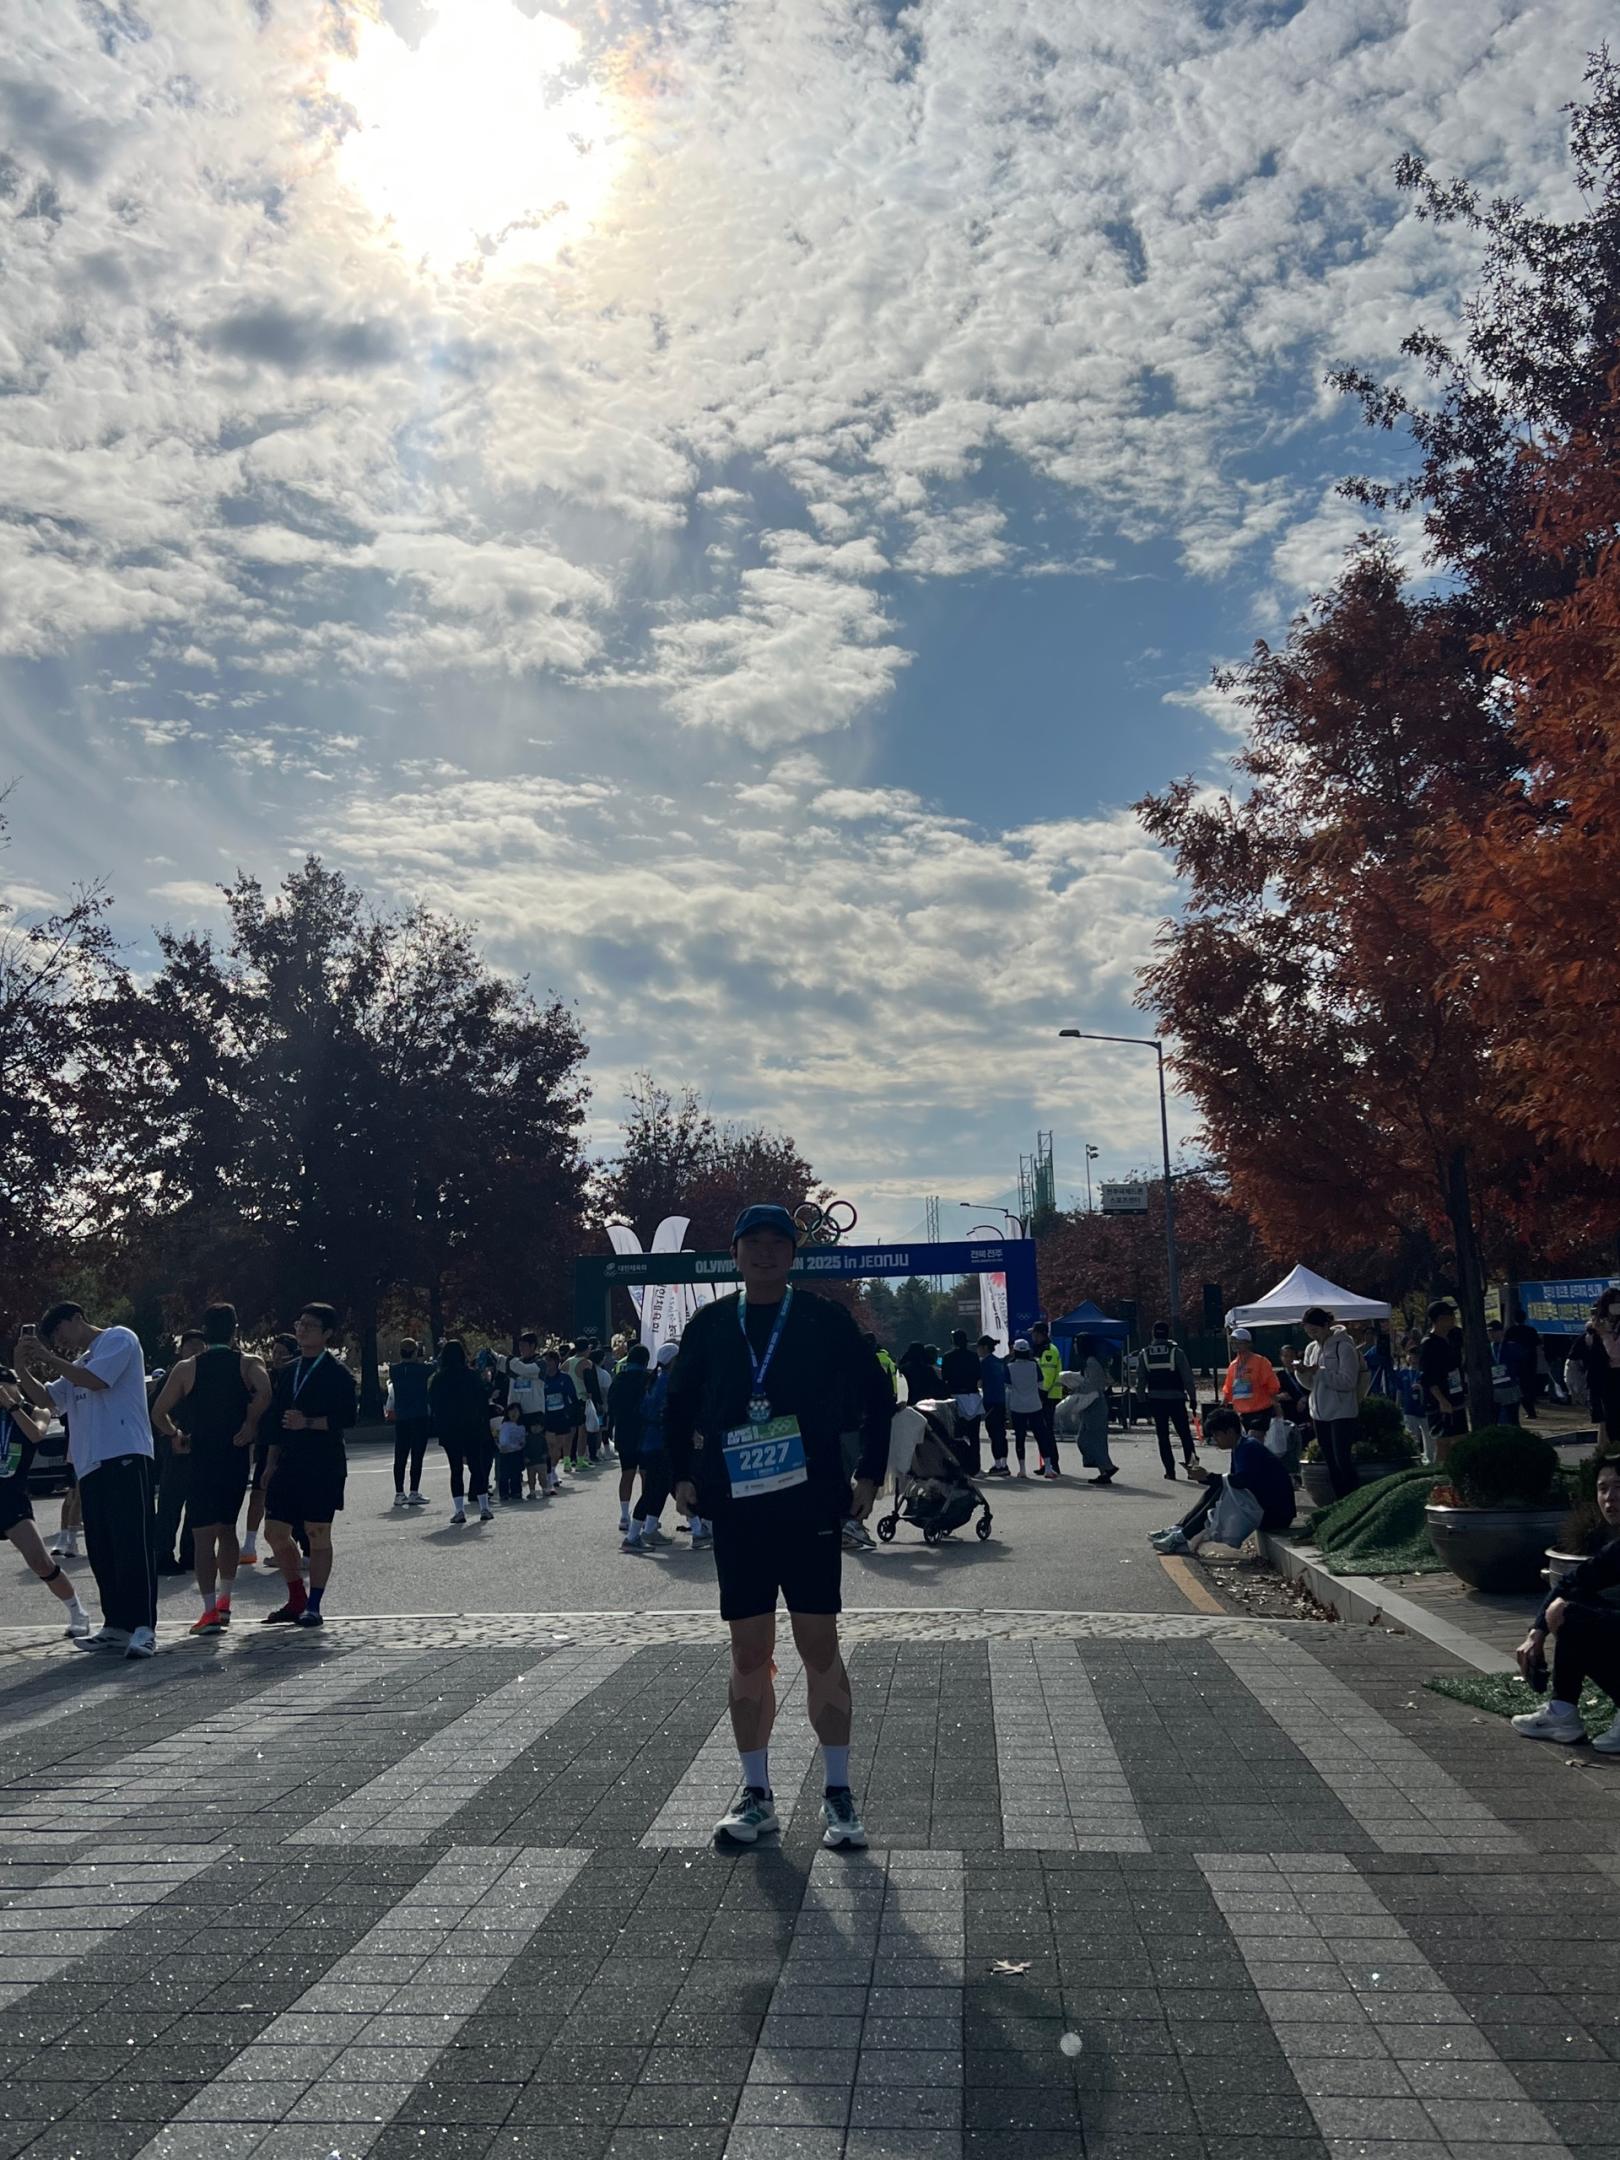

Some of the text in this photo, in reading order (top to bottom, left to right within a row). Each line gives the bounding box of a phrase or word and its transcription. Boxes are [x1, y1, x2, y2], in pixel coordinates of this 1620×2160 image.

[806, 1255, 842, 1270] 2025
[844, 1255, 856, 1269] in
[858, 1253, 909, 1268] JEONJU
[740, 1441, 790, 1471] 2227
